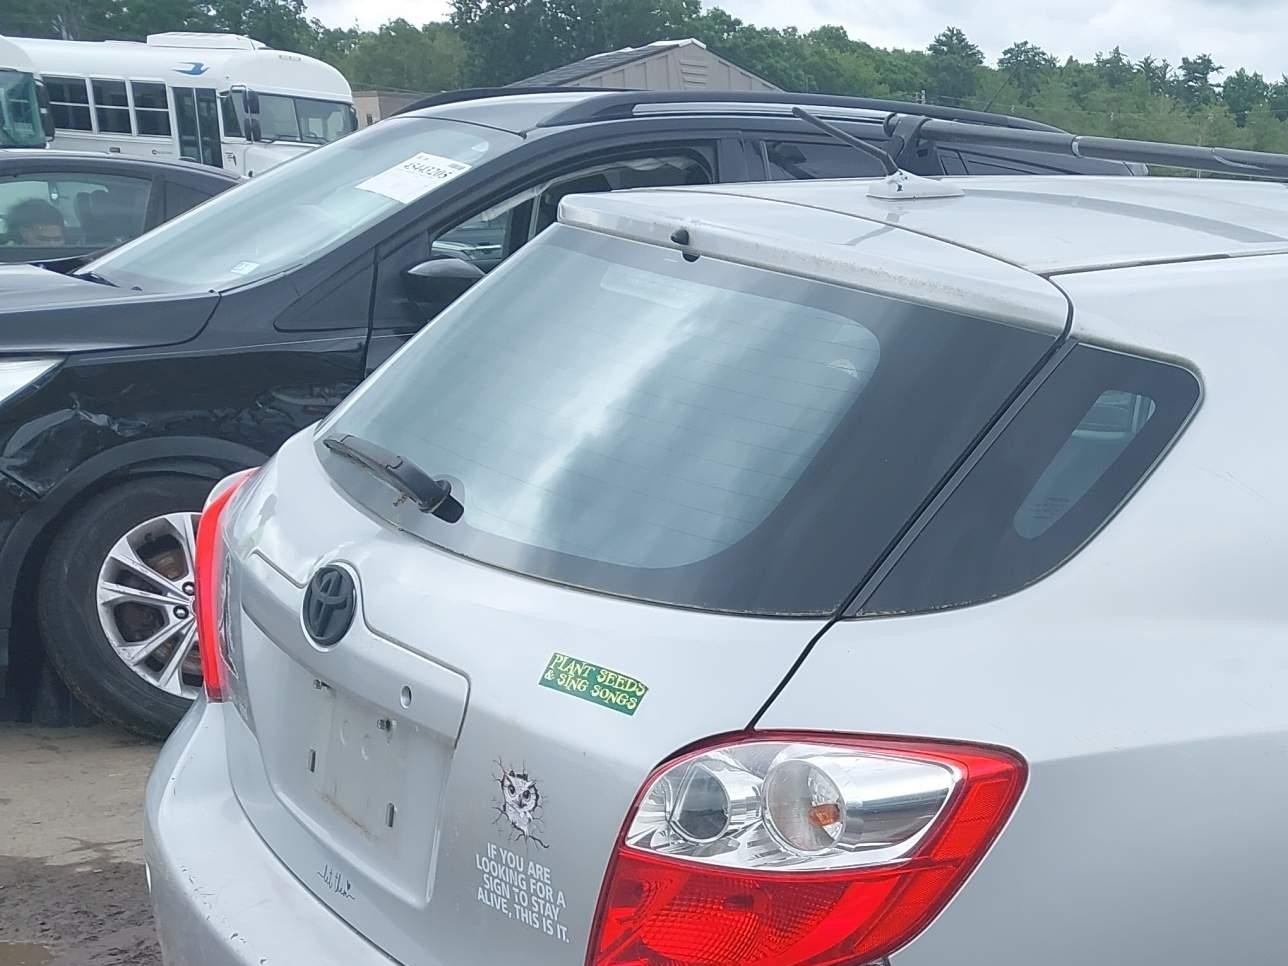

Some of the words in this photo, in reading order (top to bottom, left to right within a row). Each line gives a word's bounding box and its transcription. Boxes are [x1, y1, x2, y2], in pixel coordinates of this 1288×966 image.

[544, 670, 555, 680] &
[557, 673, 589, 691] SING
[590, 684, 638, 709] SONGS
[549, 654, 595, 677] PLANT
[596, 669, 646, 696] SEEDS
[475, 853, 527, 890] LOOKING
[529, 878, 553, 903] FOR
[556, 891, 566, 908] A
[487, 842, 497, 859] IF
[499, 847, 524, 872] YOU
[527, 861, 551, 885] ARE
[477, 887, 512, 919] ALIVE,
[514, 903, 539, 929] THIS
[542, 917, 554, 936] IS
[556, 923, 570, 944] IT.
[483, 873, 510, 899] SIGN
[512, 886, 528, 907] TO
[532, 896, 559, 921] STAY
